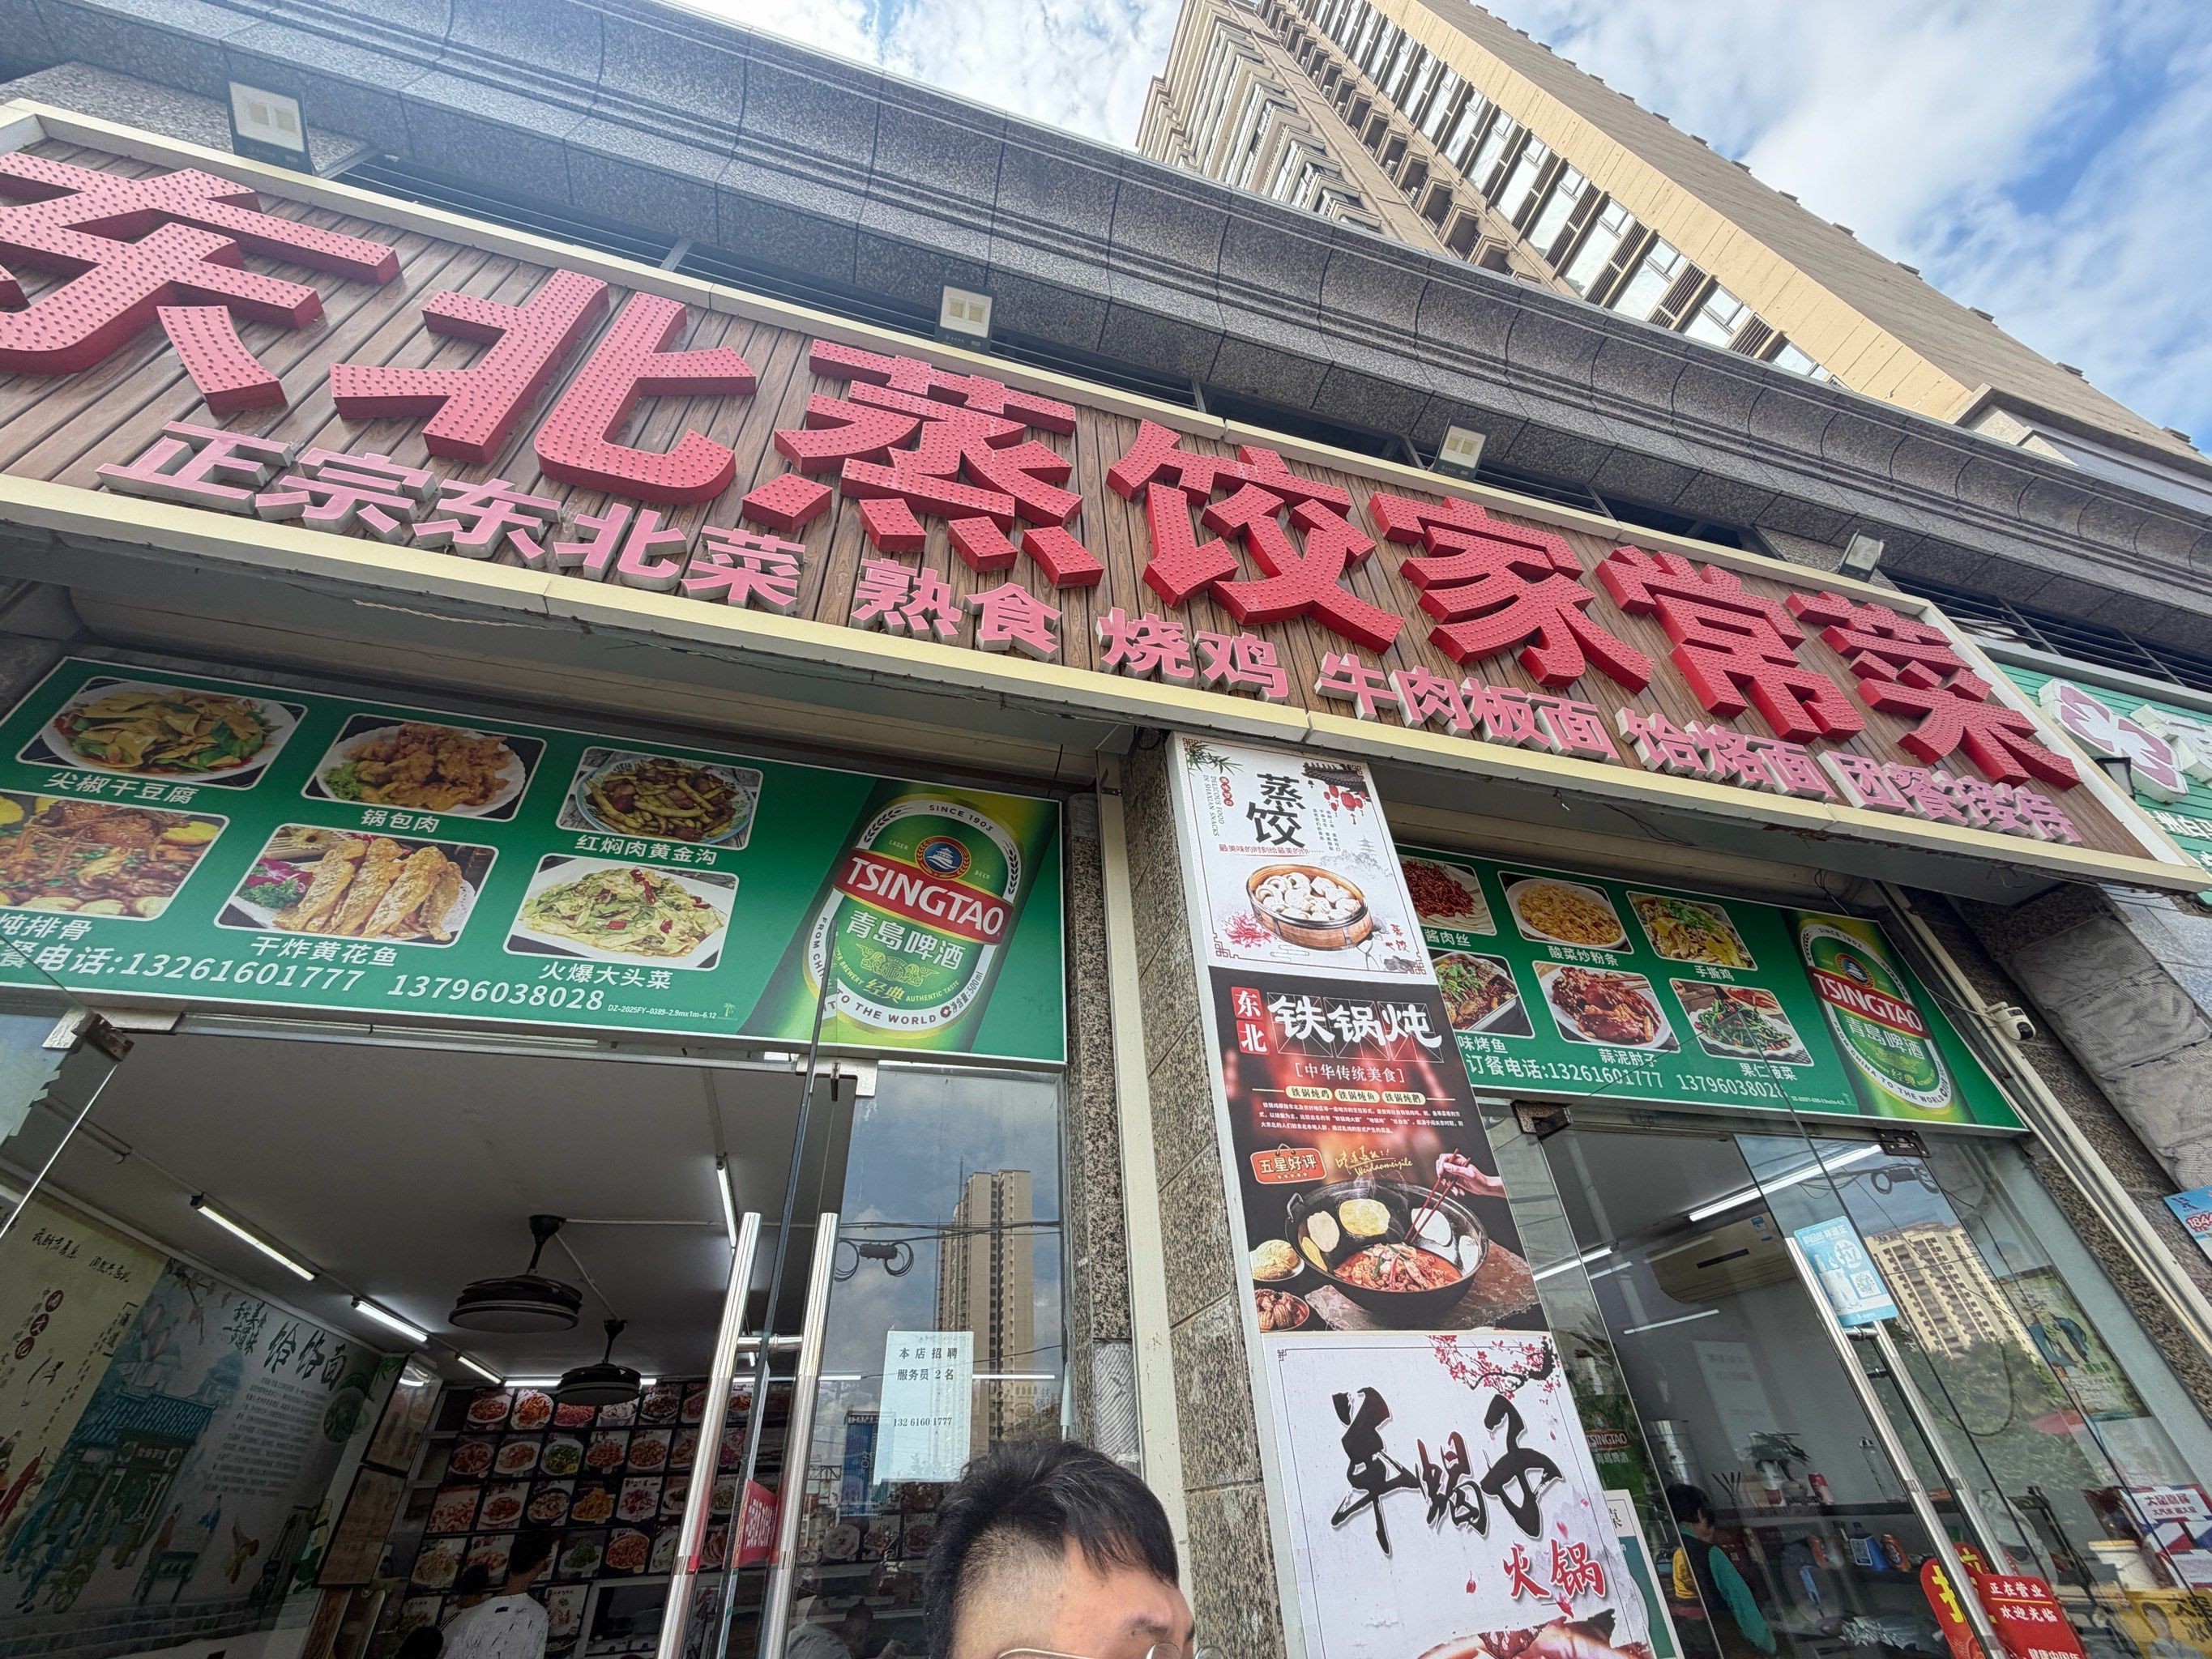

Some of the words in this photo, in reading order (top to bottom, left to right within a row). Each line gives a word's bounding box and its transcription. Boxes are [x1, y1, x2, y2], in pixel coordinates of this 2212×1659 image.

[0, 151, 2082, 791] 东北蒸饺家常菜
[96, 420, 806, 616] 正宗东北菜
[851, 558, 1062, 662] 熟食
[1096, 607, 1290, 705] 烧鸡
[1314, 651, 1621, 766] 牛肉板面
[1817, 750, 2083, 845] 团餐接待
[43, 770, 199, 805] 尖椒干豆腐
[361, 808, 440, 834] 锅包肉
[929, 804, 964, 817] SINCE
[968, 813, 994, 832] 1903
[1245, 772, 1306, 849] 蒸饺
[574, 834, 718, 866] 红焖肉黄金沟
[847, 856, 1005, 935] TSINGTAO
[0, 913, 92, 940] 炖排骨
[846, 910, 966, 970] 青島啤酒
[1424, 928, 1471, 947] 酱肉丝
[250, 935, 398, 967] 干炸黄花鱼
[1547, 945, 1620, 966] 酸菜炒粉条
[0, 938, 366, 993] 餐电话:13261601777
[386, 974, 605, 1012] 13796038028
[538, 961, 674, 991] 火爆大头菜
[813, 917, 826, 949] FROM
[837, 987, 851, 1004] TO
[855, 1001, 882, 1020] THE
[888, 1014, 937, 1026] WORLD
[864, 978, 906, 1004] 经典
[905, 990, 943, 1003] AUTHENTIC
[1813, 972, 1924, 1032] TSINGTAO
[1234, 990, 1268, 1053] 东北
[1267, 995, 1442, 1048] 铁锅炖
[1458, 1035, 1509, 1054] 味烤鱼
[1844, 1014, 1925, 1060] 青島啤酒
[1598, 1047, 1658, 1068] 蒜泥肘子
[1676, 1073, 1789, 1098] 13796038028
[1881, 1076, 1894, 1089] TO
[1898, 1086, 1917, 1100] THE
[1258, 1154, 1317, 1174] 五星好评
[899, 1347, 958, 1359] 本店招聘
[893, 1418, 907, 1427] 132
[910, 1418, 930, 1426] 6160
[933, 1417, 953, 1426] 1777
[1331, 1386, 1564, 1555] 羊蝎子
[1503, 1538, 1608, 1600] 火锅
[1989, 1581, 2046, 1597] 正在营业
[2000, 1605, 2058, 1623] 欢迎光临
